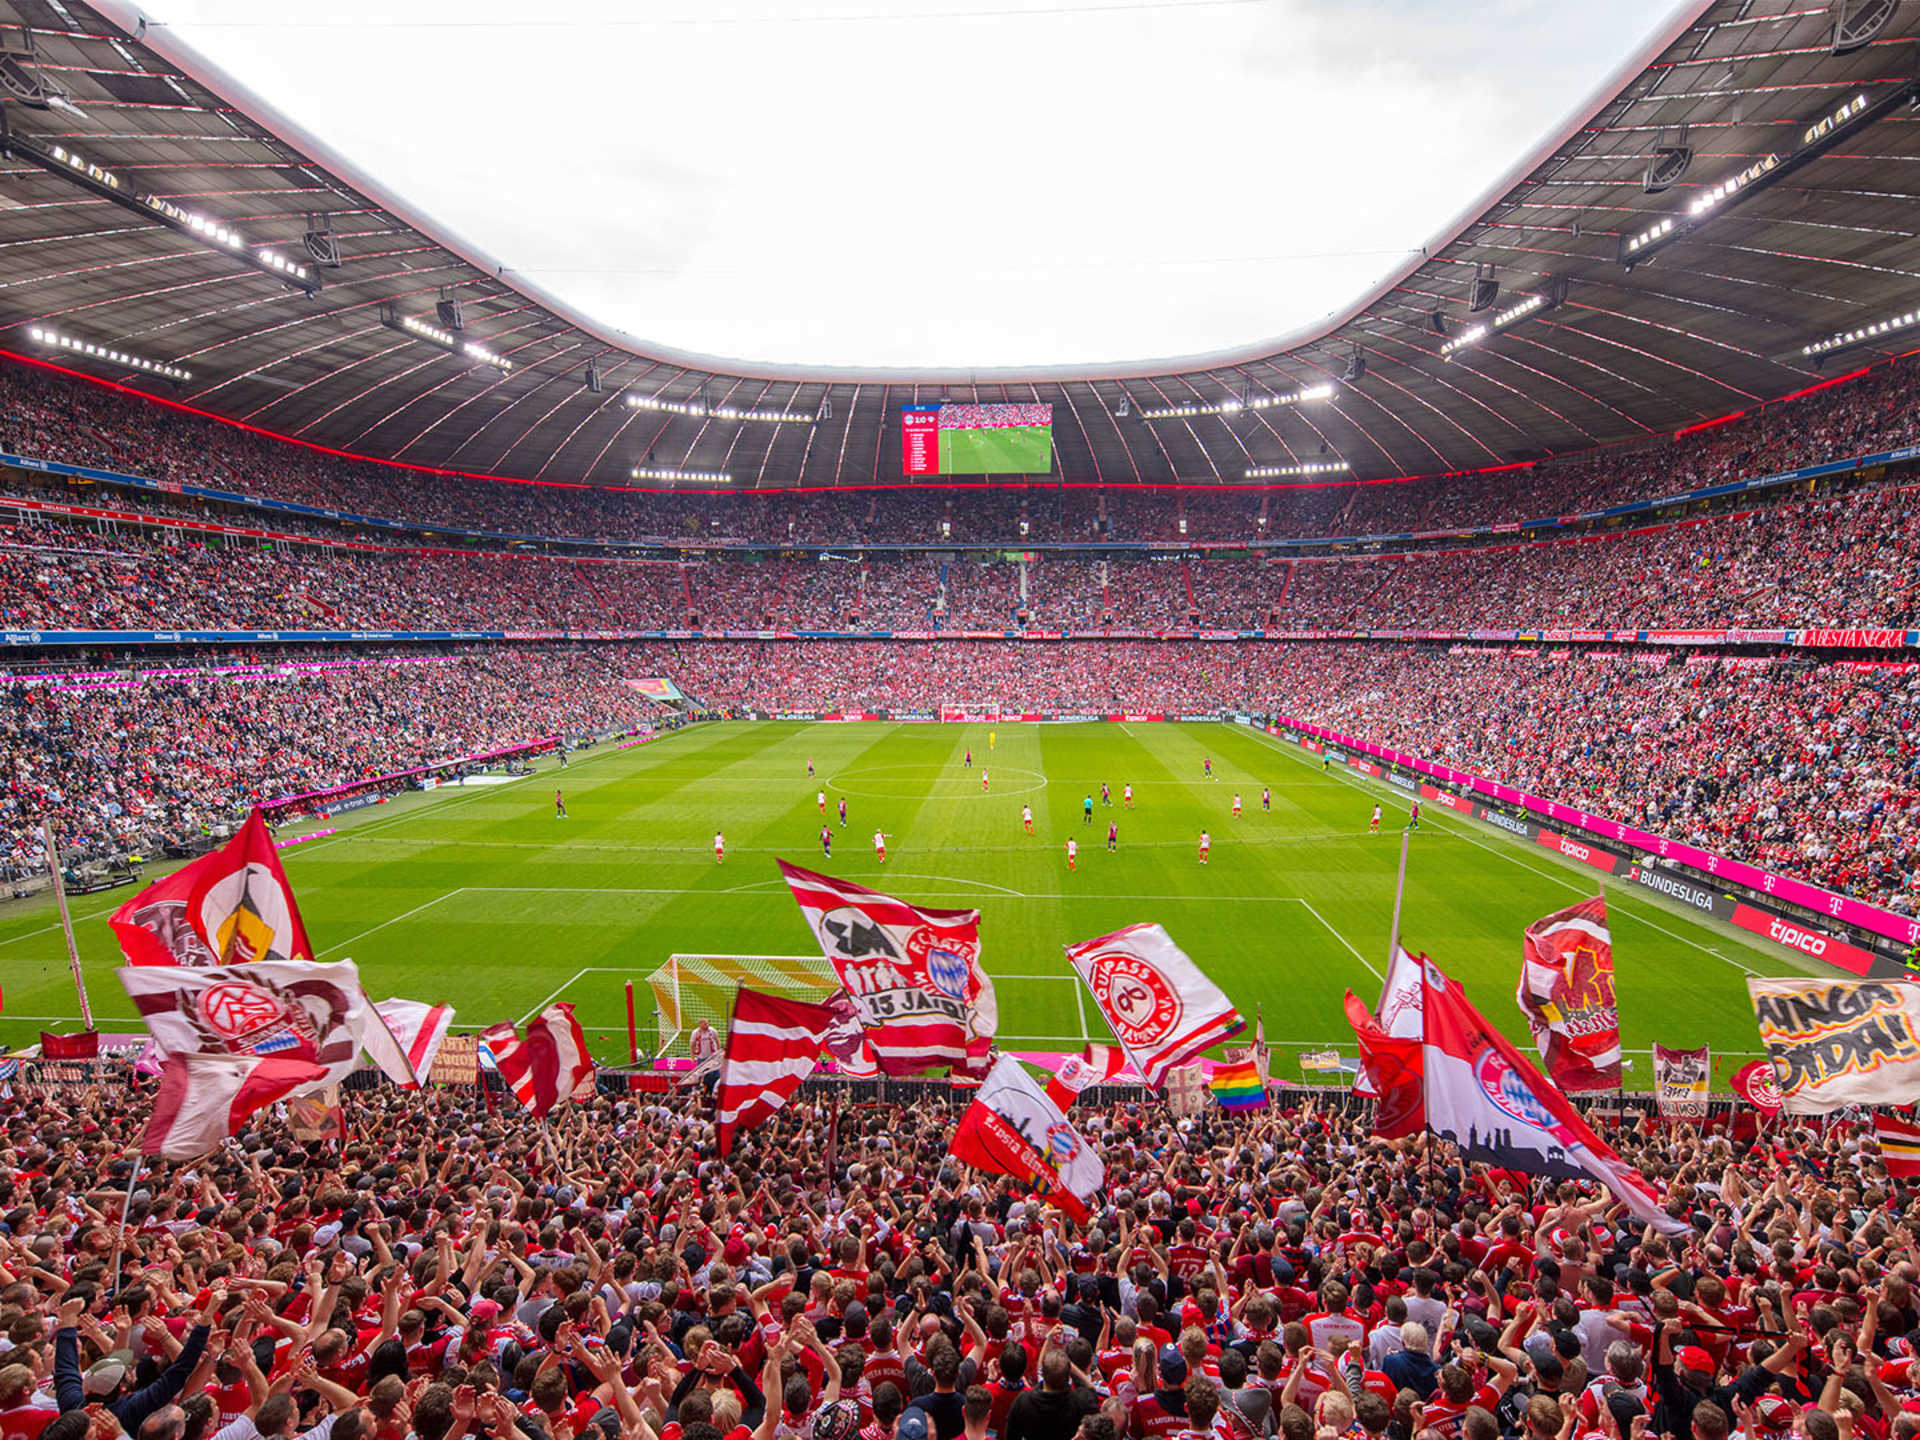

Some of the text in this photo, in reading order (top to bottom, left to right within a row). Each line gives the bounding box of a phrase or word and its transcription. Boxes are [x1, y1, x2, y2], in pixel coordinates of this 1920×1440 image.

[1486, 812, 1528, 836] BUNDESLIGA
[1560, 836, 1589, 860] tipico
[1640, 871, 1713, 912] BUNDESLIGA
[1770, 918, 1826, 955] tipico
